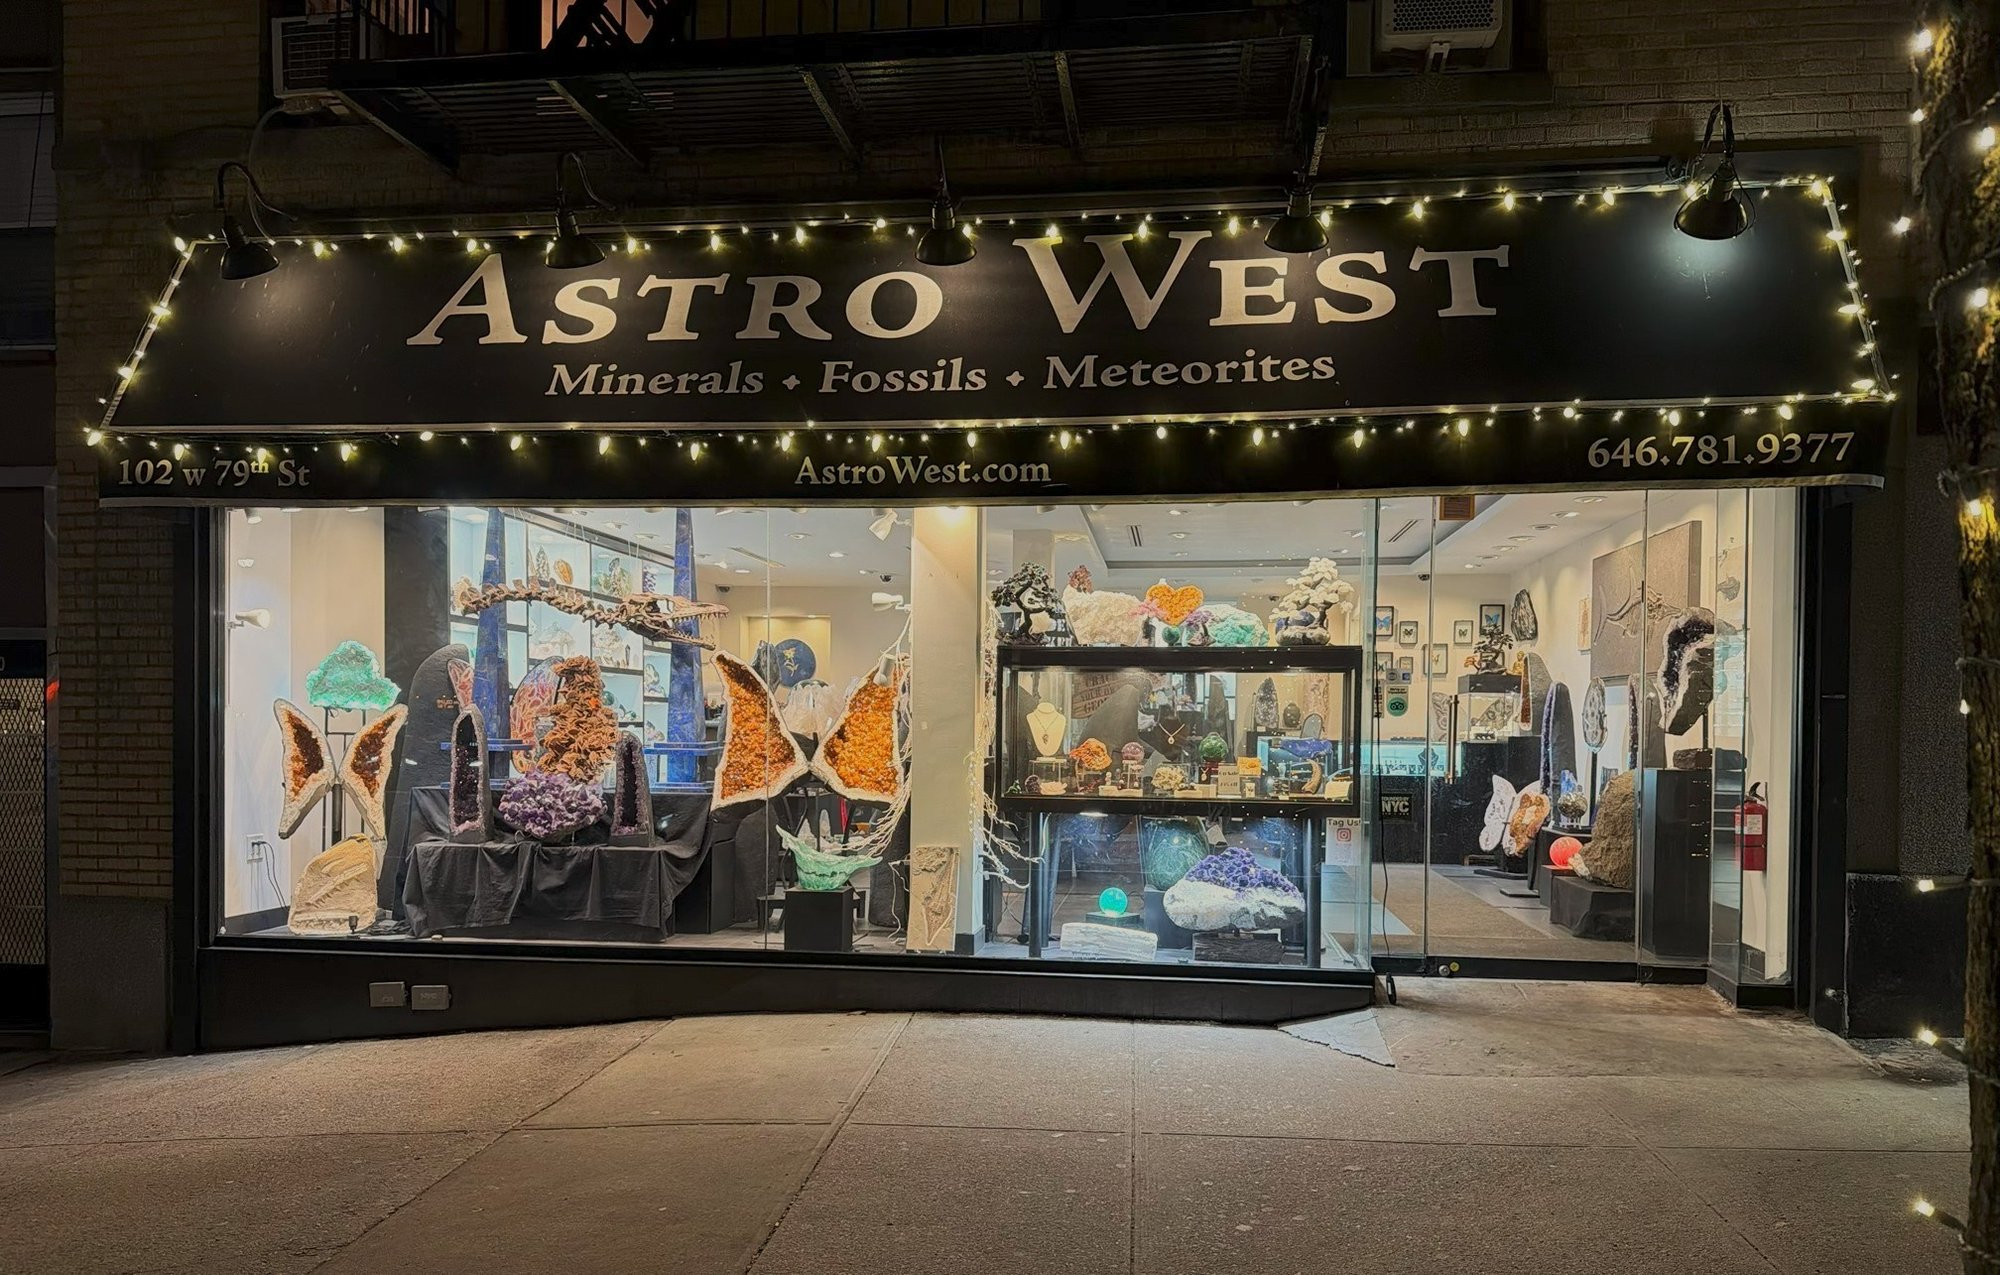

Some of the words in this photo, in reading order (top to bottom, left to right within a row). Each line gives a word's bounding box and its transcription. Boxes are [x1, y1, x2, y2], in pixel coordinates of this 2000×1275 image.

[545, 360, 764, 396] Minerals
[818, 356, 987, 393] Fossils
[1043, 349, 1336, 389] Meteorites
[1587, 431, 1855, 468] 646.781.9377
[118, 458, 174, 485] 102
[182, 467, 206, 486] w
[213, 458, 270, 487] 79th
[276, 458, 311, 487] St
[794, 455, 1053, 485] AstroWest.com
[1381, 800, 1410, 813] NYC
[1327, 818, 1345, 827] Tag
